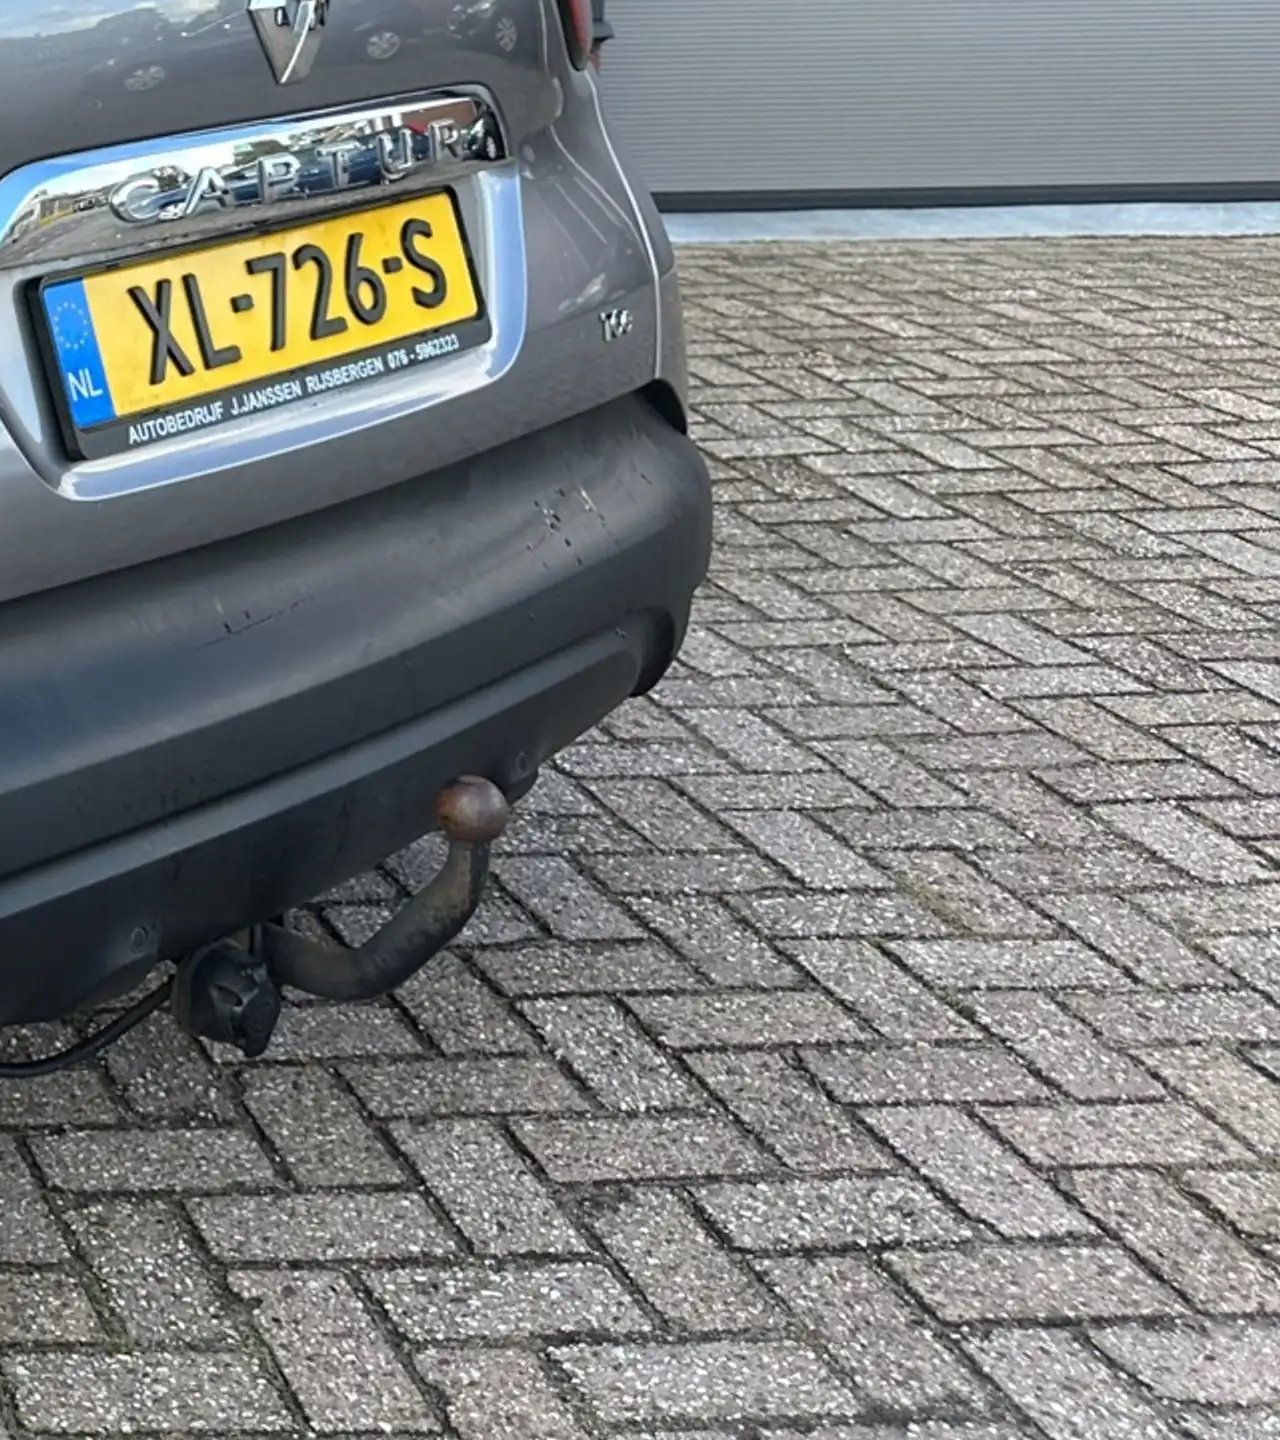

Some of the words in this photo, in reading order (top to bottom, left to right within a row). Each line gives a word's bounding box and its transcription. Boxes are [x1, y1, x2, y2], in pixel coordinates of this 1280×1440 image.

[108, 118, 464, 224] CAPTUR
[127, 217, 448, 386] XL-726-S
[68, 368, 103, 402] NL
[128, 400, 225, 445] AUTOBEDRIJF
[306, 356, 386, 394] RIJSBERGEN
